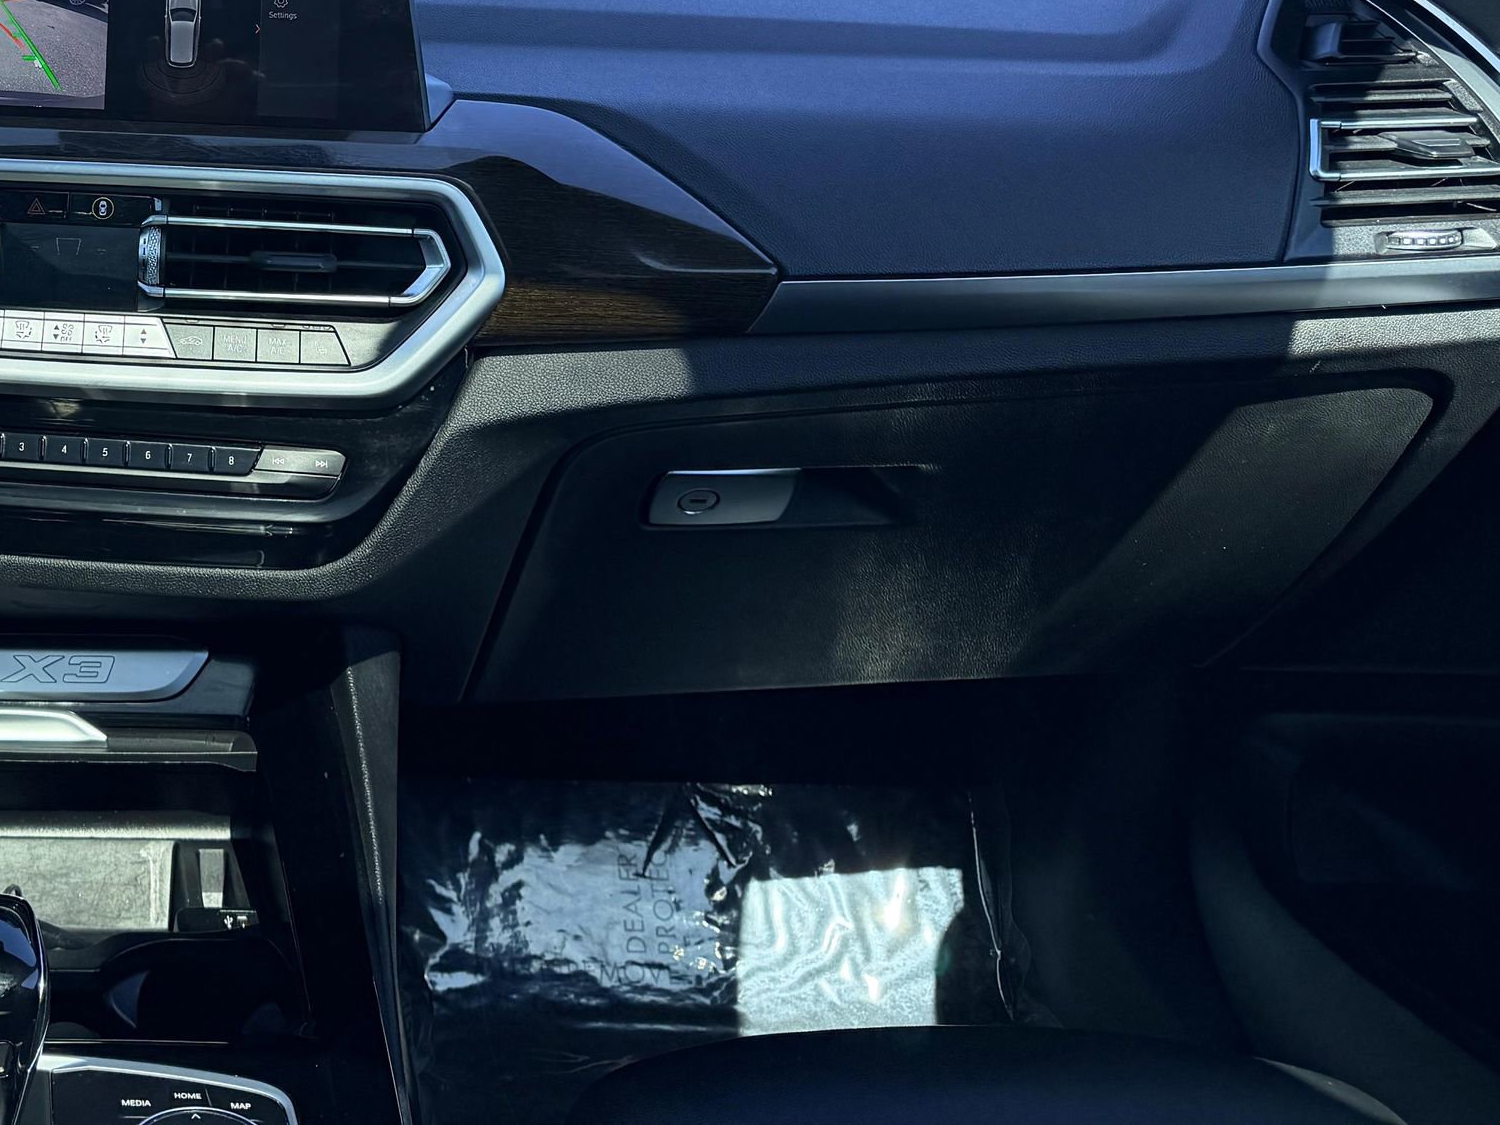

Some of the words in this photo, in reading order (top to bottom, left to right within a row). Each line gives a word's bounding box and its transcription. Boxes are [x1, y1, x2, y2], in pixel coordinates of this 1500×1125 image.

[268, 10, 298, 21] Settings
[223, 334, 248, 344] MENU
[227, 344, 244, 354] A/C
[18, 442, 25, 451] 3
[61, 445, 67, 454] 4
[102, 447, 108, 457] 5
[145, 451, 151, 460] 6
[187, 453, 193, 463] 7
[228, 456, 235, 466] 8
[0, 654, 116, 684] X3
[617, 852, 647, 954] DEALER
[173, 1092, 202, 1100] HOME
[121, 1099, 152, 1107] MEDIA
[230, 1102, 252, 1110] MAP
